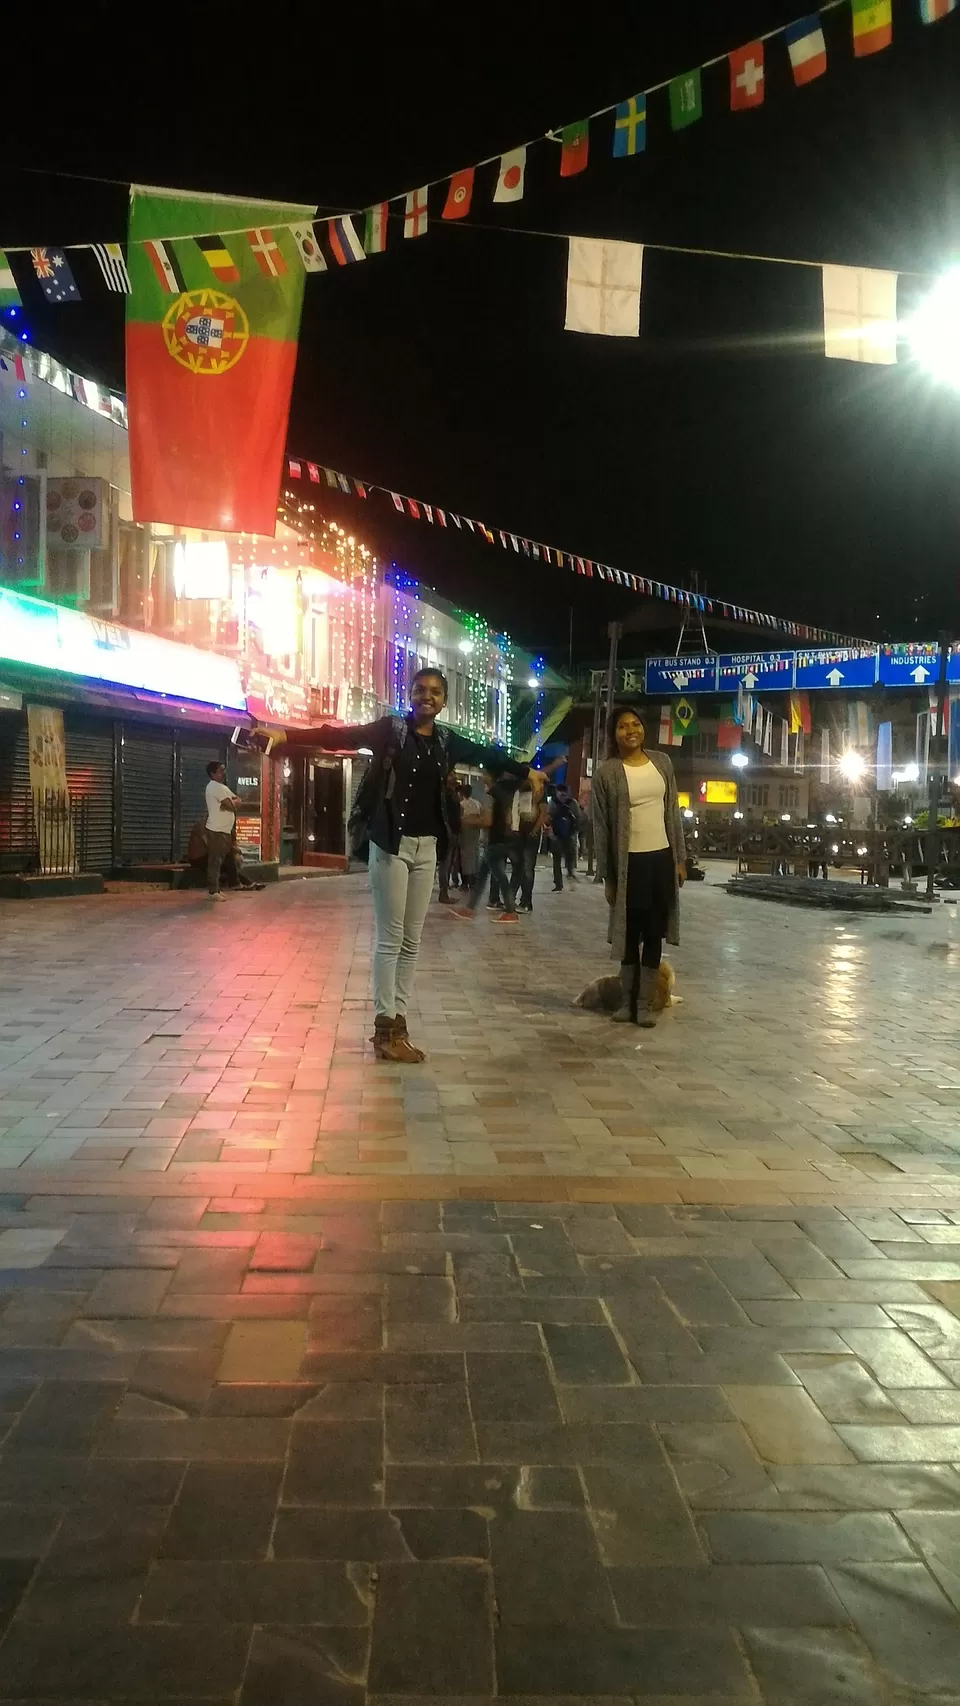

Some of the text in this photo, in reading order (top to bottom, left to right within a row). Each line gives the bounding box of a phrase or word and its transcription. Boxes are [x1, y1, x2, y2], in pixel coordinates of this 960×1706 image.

[665, 659, 677, 667] BUS
[679, 658, 702, 667] STAND
[731, 654, 765, 664] HOSPITAL
[890, 655, 937, 665] INDUSTRIES
